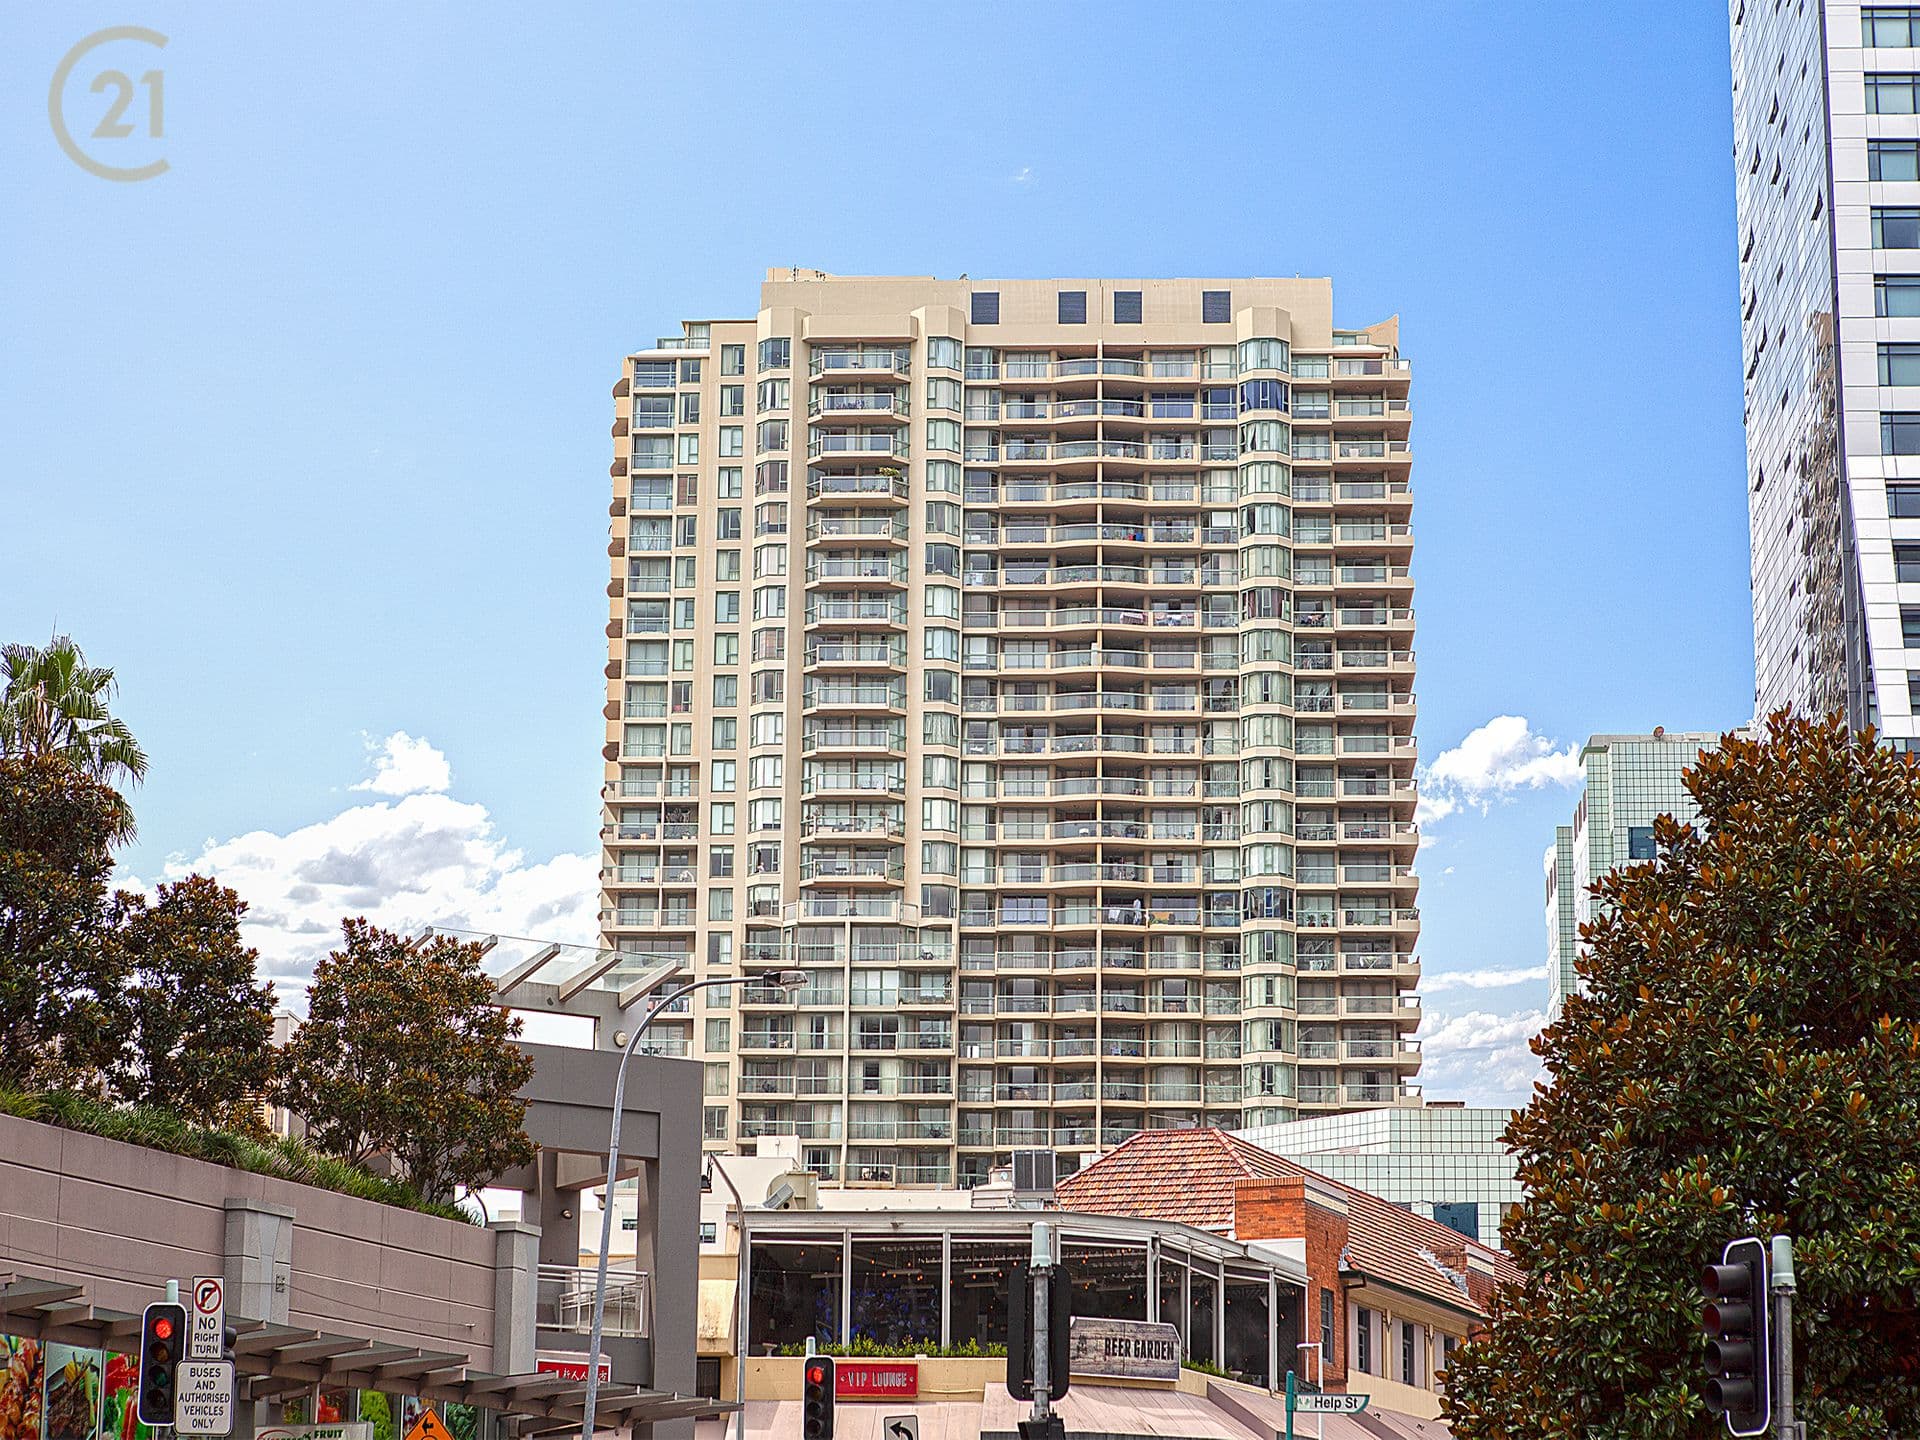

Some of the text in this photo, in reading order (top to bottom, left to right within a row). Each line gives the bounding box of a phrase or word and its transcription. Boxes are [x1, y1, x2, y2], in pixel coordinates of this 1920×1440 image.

[198, 1317, 216, 1330] NO
[193, 1333, 220, 1343] RIGHT
[194, 1344, 219, 1354] TURN
[1104, 1337, 1175, 1361] BEER GARDEN
[189, 1367, 221, 1378] BUSES
[847, 1371, 908, 1388] VIP LOUNGE
[194, 1380, 216, 1391] AND
[178, 1392, 230, 1404] AUTHORISED
[1314, 1397, 1358, 1411] Help St
[184, 1405, 224, 1416] VEHICLES
[191, 1418, 215, 1429] ONLY
[314, 1429, 344, 1439] FRUIT
